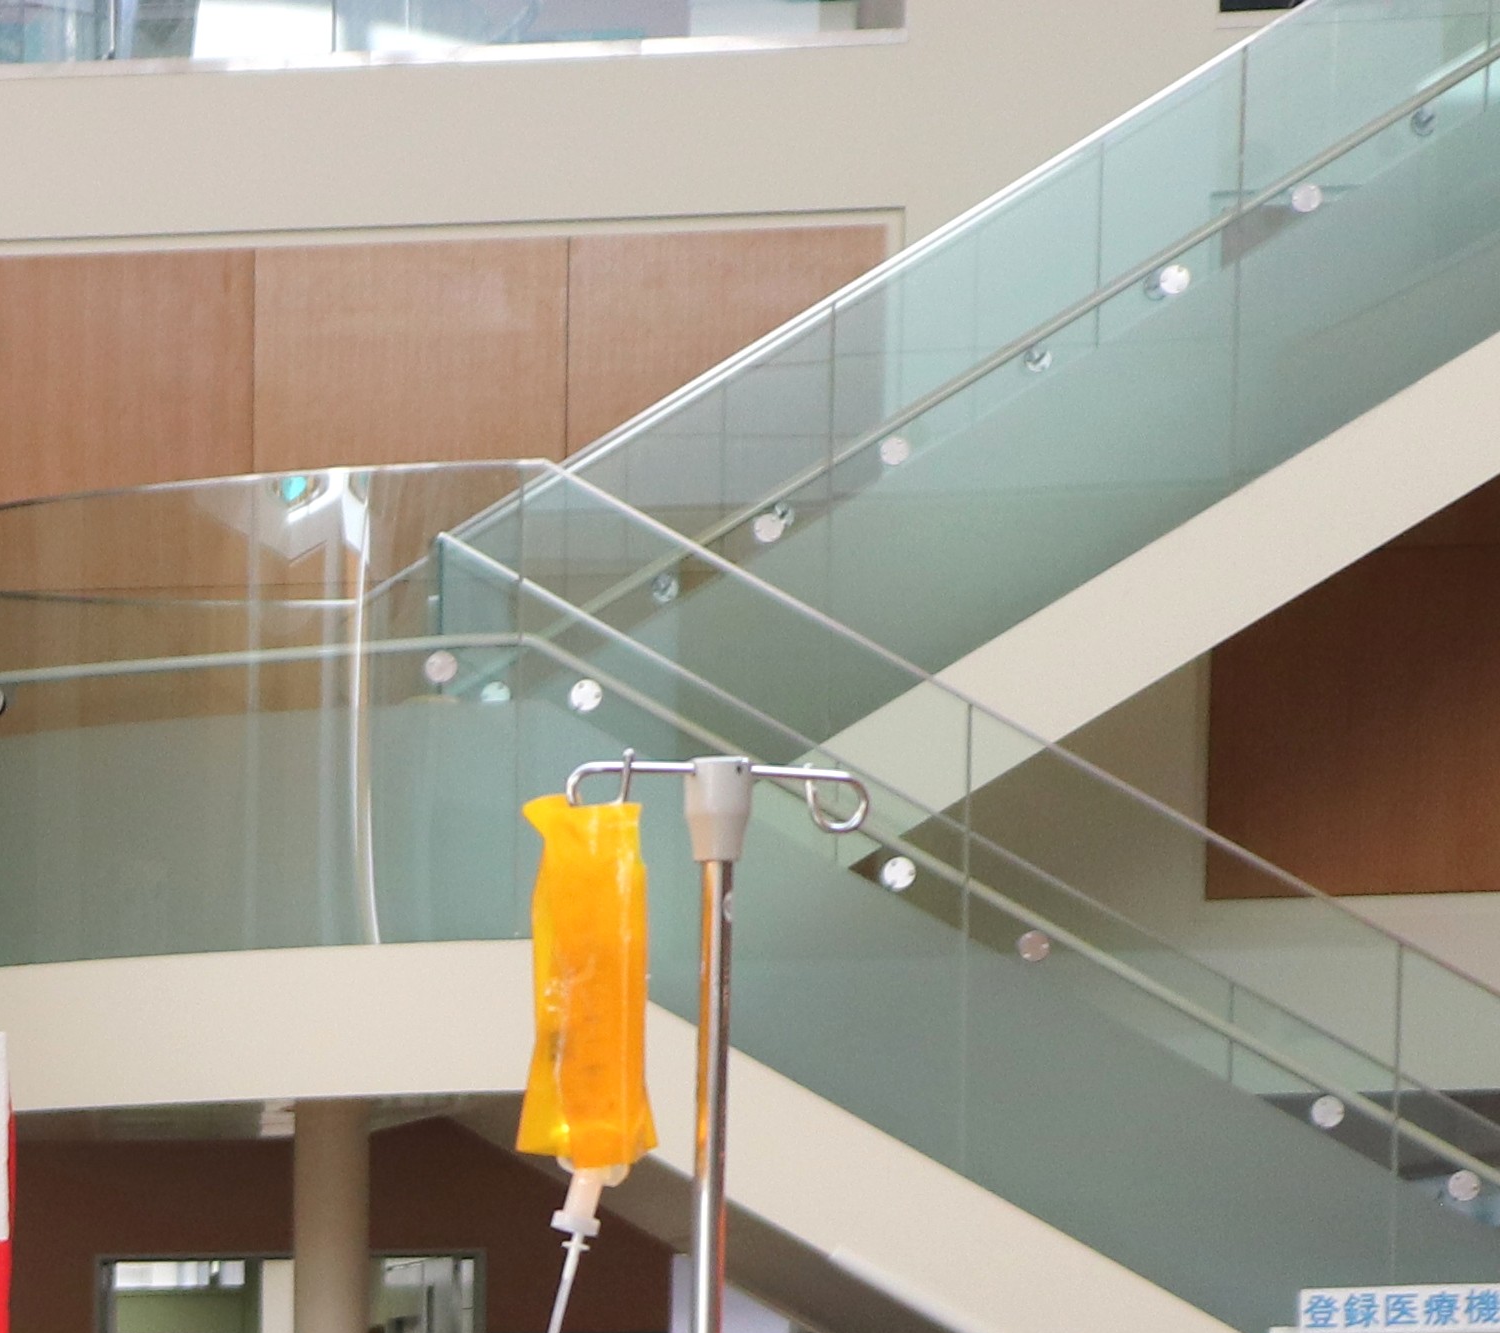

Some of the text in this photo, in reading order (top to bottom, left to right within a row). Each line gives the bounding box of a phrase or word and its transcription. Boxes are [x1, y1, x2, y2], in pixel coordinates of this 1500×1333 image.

[1304, 1289, 1500, 1329] 登録医療機
